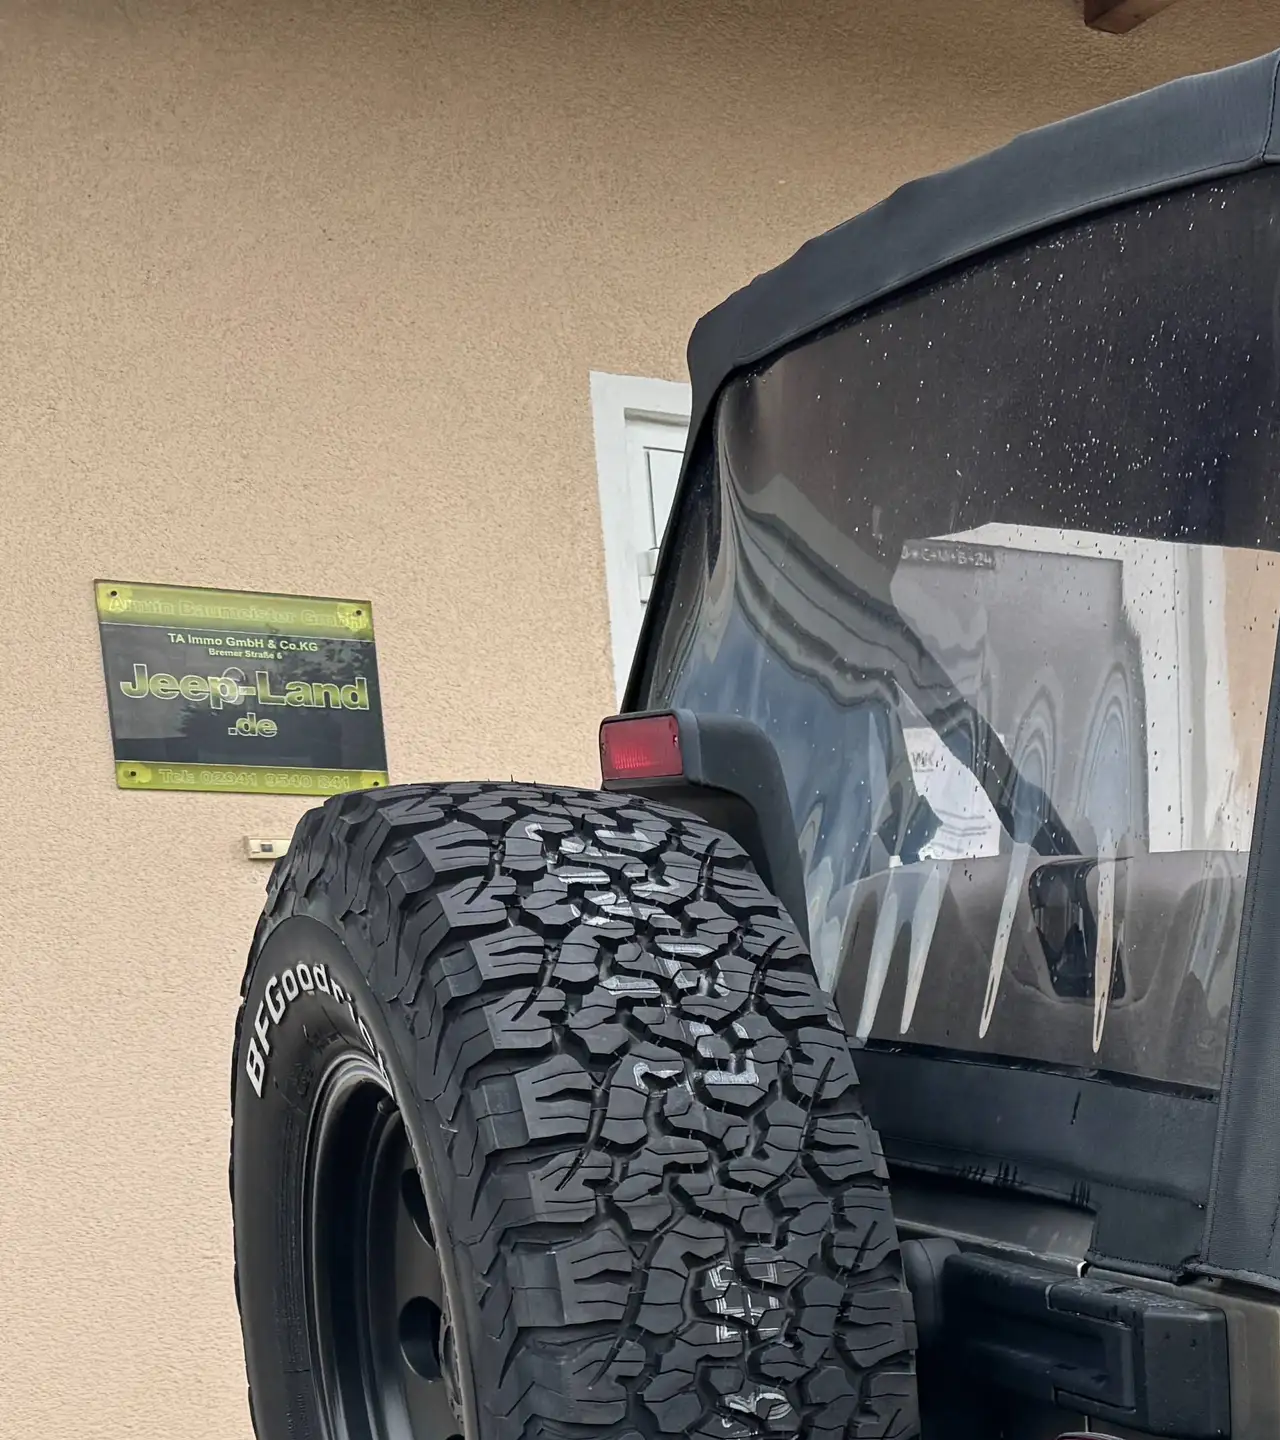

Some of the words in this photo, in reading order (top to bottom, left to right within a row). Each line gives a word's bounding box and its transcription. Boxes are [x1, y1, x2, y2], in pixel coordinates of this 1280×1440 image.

[109, 596, 173, 615] Armin
[179, 600, 296, 624] Baumeister
[167, 632, 186, 644] TA
[188, 634, 223, 646] Immo
[225, 636, 264, 648] GmbH
[267, 639, 277, 649] &
[279, 640, 318, 652] Co.KG
[208, 647, 242, 658] Bremer
[244, 650, 275, 660] Straße
[119, 664, 370, 711] Jeep-Land
[227, 712, 279, 737] .de
